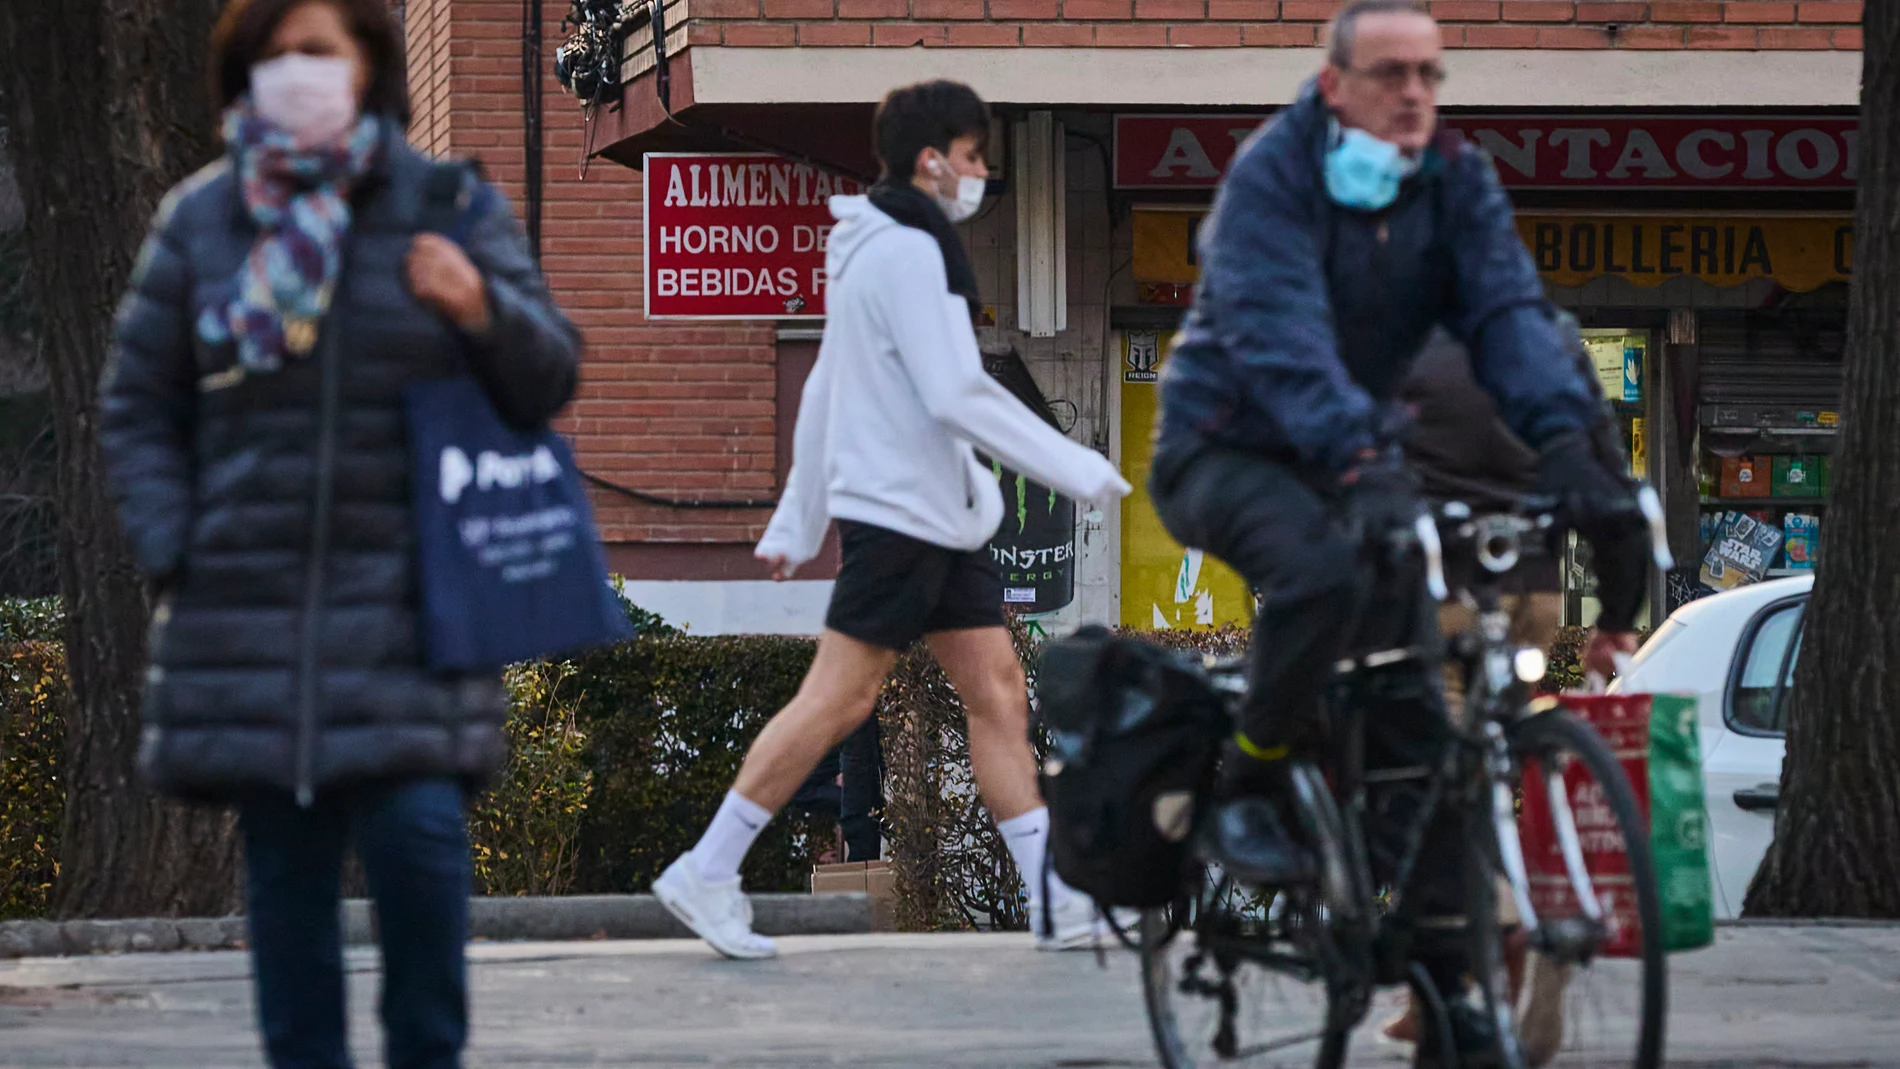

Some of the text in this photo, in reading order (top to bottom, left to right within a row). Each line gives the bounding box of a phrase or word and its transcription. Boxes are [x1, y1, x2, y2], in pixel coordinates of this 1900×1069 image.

[660, 224, 779, 254] HORNO
[1535, 222, 1773, 276] BOLLERIA
[657, 267, 798, 296] BEBIDAS
[1128, 372, 1156, 380] REIGN
[1719, 545, 1762, 569] WARS
[1720, 538, 1762, 562] STAR
[1000, 568, 1065, 582] ERGY
